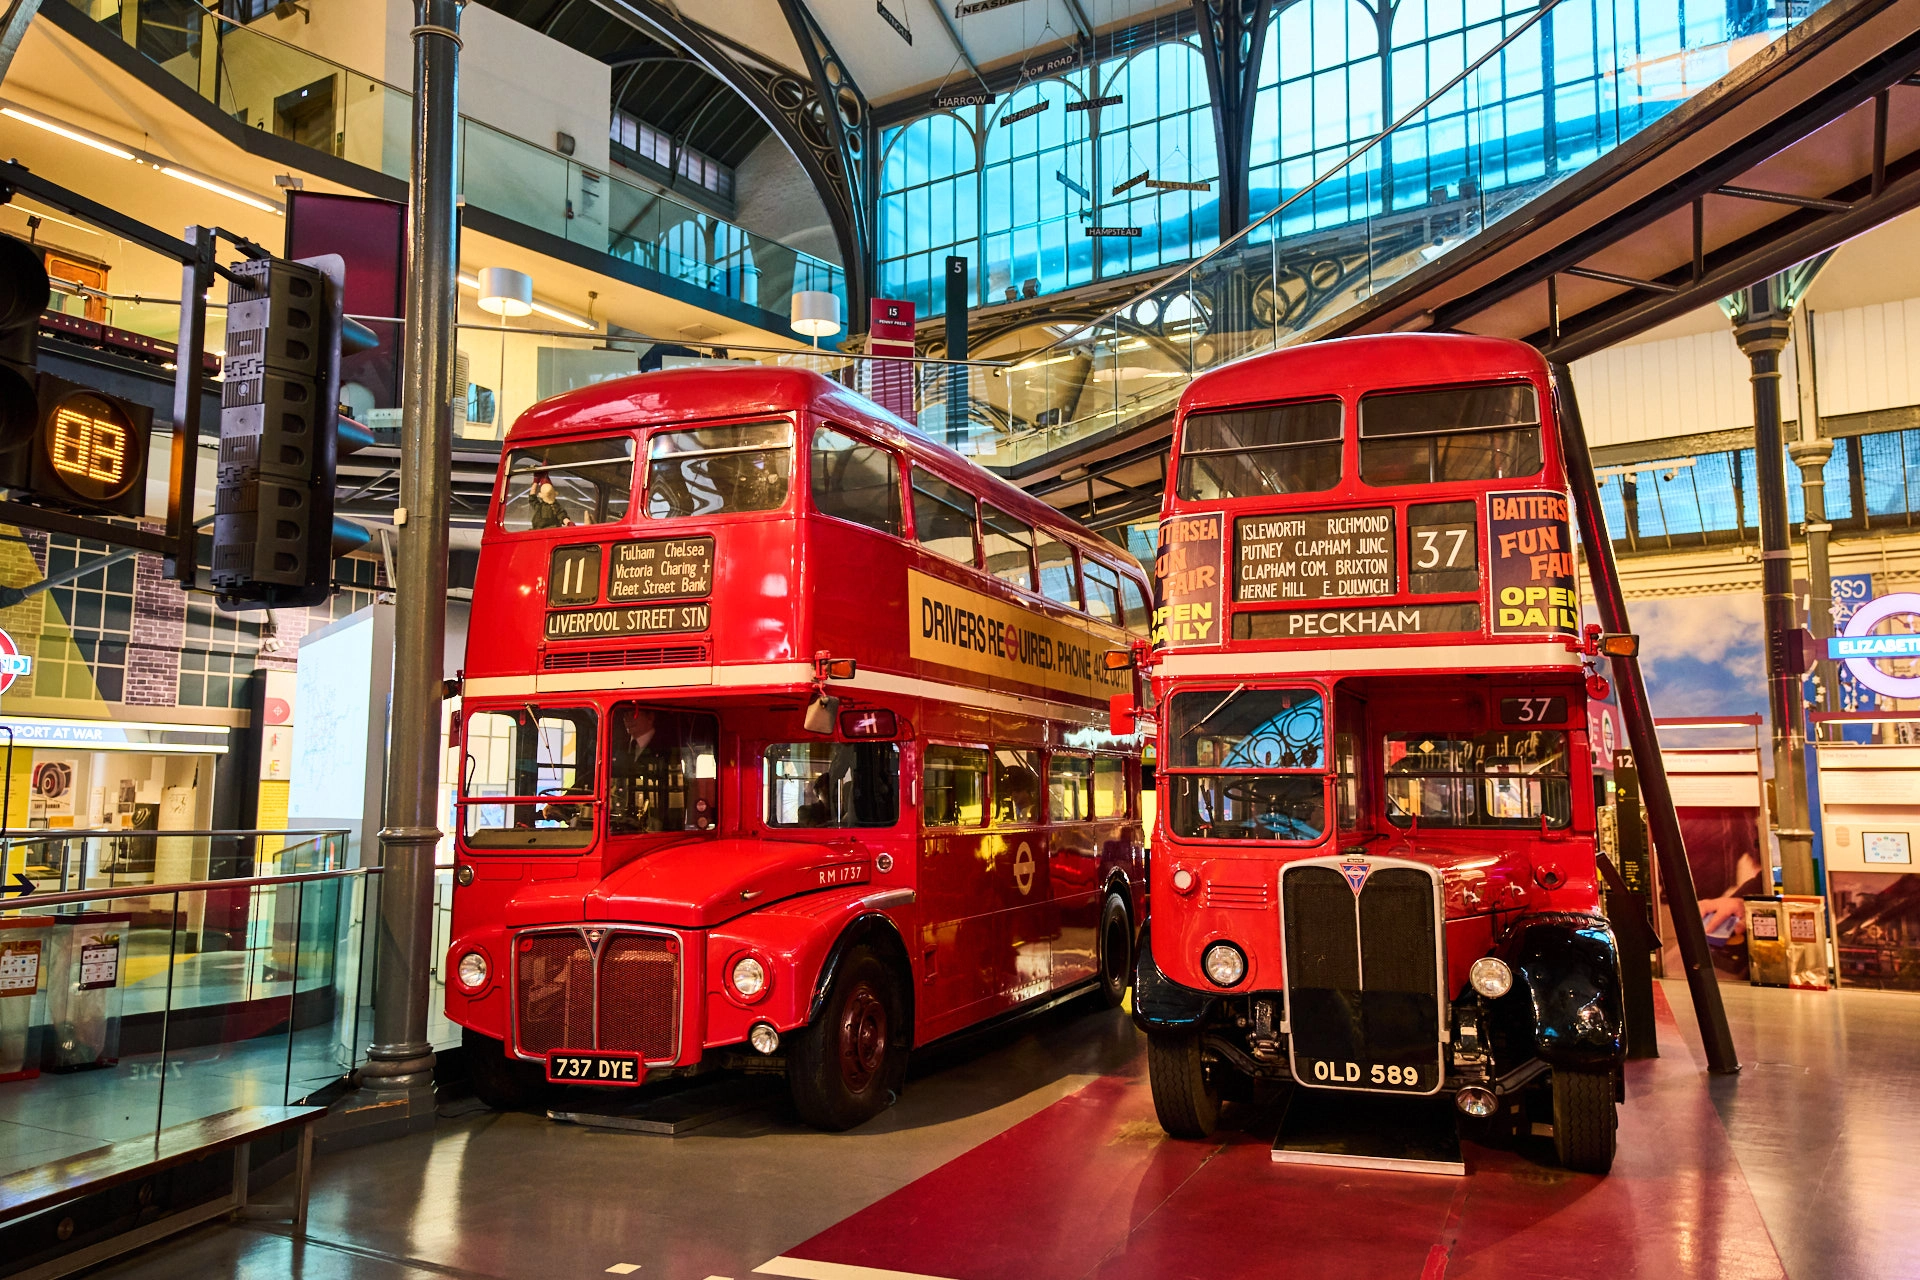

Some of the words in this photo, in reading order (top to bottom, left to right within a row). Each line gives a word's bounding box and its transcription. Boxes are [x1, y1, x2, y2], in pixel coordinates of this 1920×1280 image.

[963, 0, 1022, 14] NEASD
[1047, 55, 1073, 70] ROAD
[938, 95, 986, 107] HARROW
[1067, 102, 1087, 112] NEW
[1089, 100, 1098, 109] X
[1089, 228, 1138, 236] HAMPSTEAD
[954, 262, 962, 273] 5
[889, 308, 898, 316] 15
[1242, 520, 1306, 541] ISLEWORTH
[1327, 515, 1389, 535] RICHMOND
[620, 545, 655, 562] Fulham
[664, 541, 705, 558] Chelsea
[1241, 541, 1283, 561] PUTNEY
[1295, 538, 1350, 557] CLAPHAM
[1356, 537, 1388, 555] JUNC.
[1416, 529, 1468, 569] 37
[1498, 526, 1560, 559] FUN
[615, 563, 653, 579] Victoria
[660, 561, 697, 578] Charing
[1154, 547, 1187, 579] UN
[1241, 561, 1296, 581] CLAPHAM
[1301, 560, 1329, 577] COM.
[1336, 558, 1388, 576] BRIXTON
[1530, 552, 1574, 581] FAI
[562, 557, 585, 595] 11
[613, 581, 639, 597] Fleet
[642, 580, 676, 595] Street
[681, 577, 706, 593] Bank
[1162, 565, 1216, 601] FAIR
[1240, 582, 1277, 599] HERNE
[1282, 581, 1307, 598] HILL
[1338, 578, 1388, 596] DULWICH
[548, 611, 620, 634] LIVERPOOL
[626, 608, 675, 630] STREET
[682, 606, 707, 628] STN
[1289, 610, 1420, 635] PECKHAM
[921, 597, 986, 654] DRIVERS
[1058, 640, 1092, 681] PHONE
[1518, 698, 1551, 721] 37
[53, 727, 72, 739] AT
[72, 728, 103, 740] WAR
[1617, 755, 1633, 768] 12
[819, 870, 836, 884] RM
[840, 866, 862, 881] 1737
[556, 1058, 592, 1077] 737
[599, 1060, 634, 1080] DYE
[1314, 1061, 1361, 1082] OLD
[1370, 1064, 1419, 1086] 589
